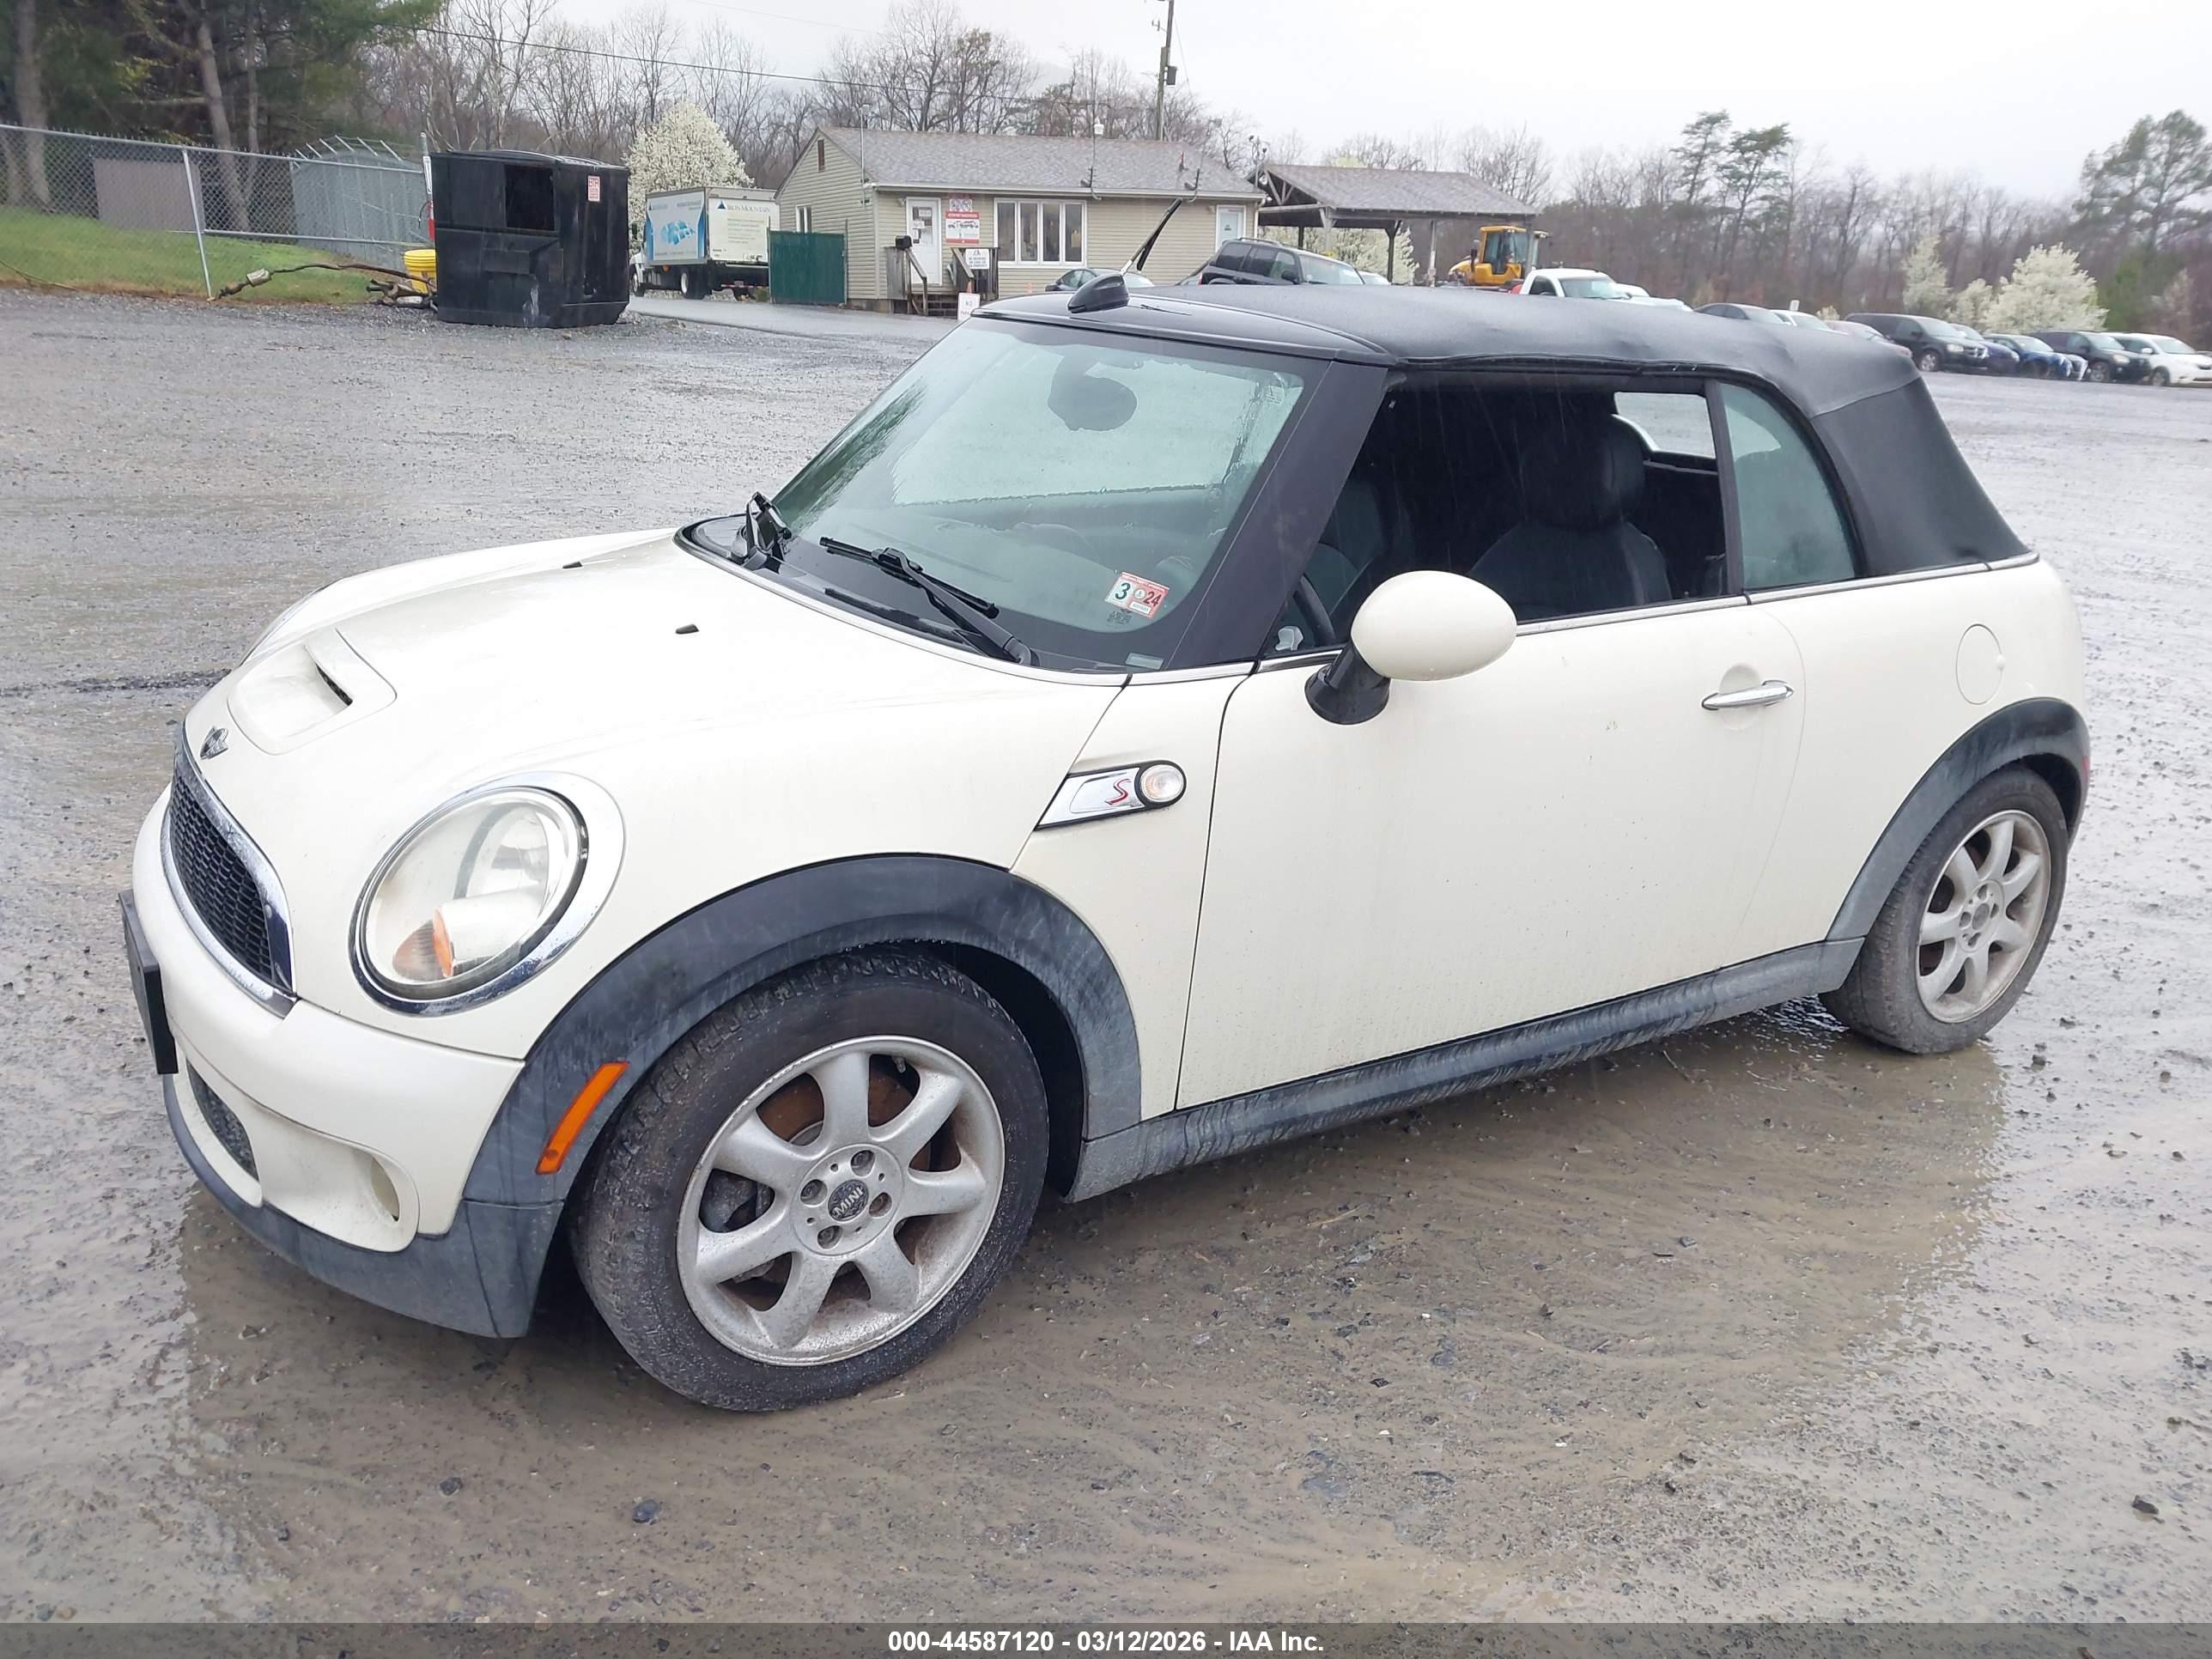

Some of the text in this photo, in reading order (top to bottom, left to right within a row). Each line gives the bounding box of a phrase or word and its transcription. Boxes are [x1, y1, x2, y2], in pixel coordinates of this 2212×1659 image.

[1115, 582, 1131, 600] 3
[1143, 591, 1162, 607] 24
[1104, 778, 1132, 805] S
[832, 1187, 864, 1218] MINI
